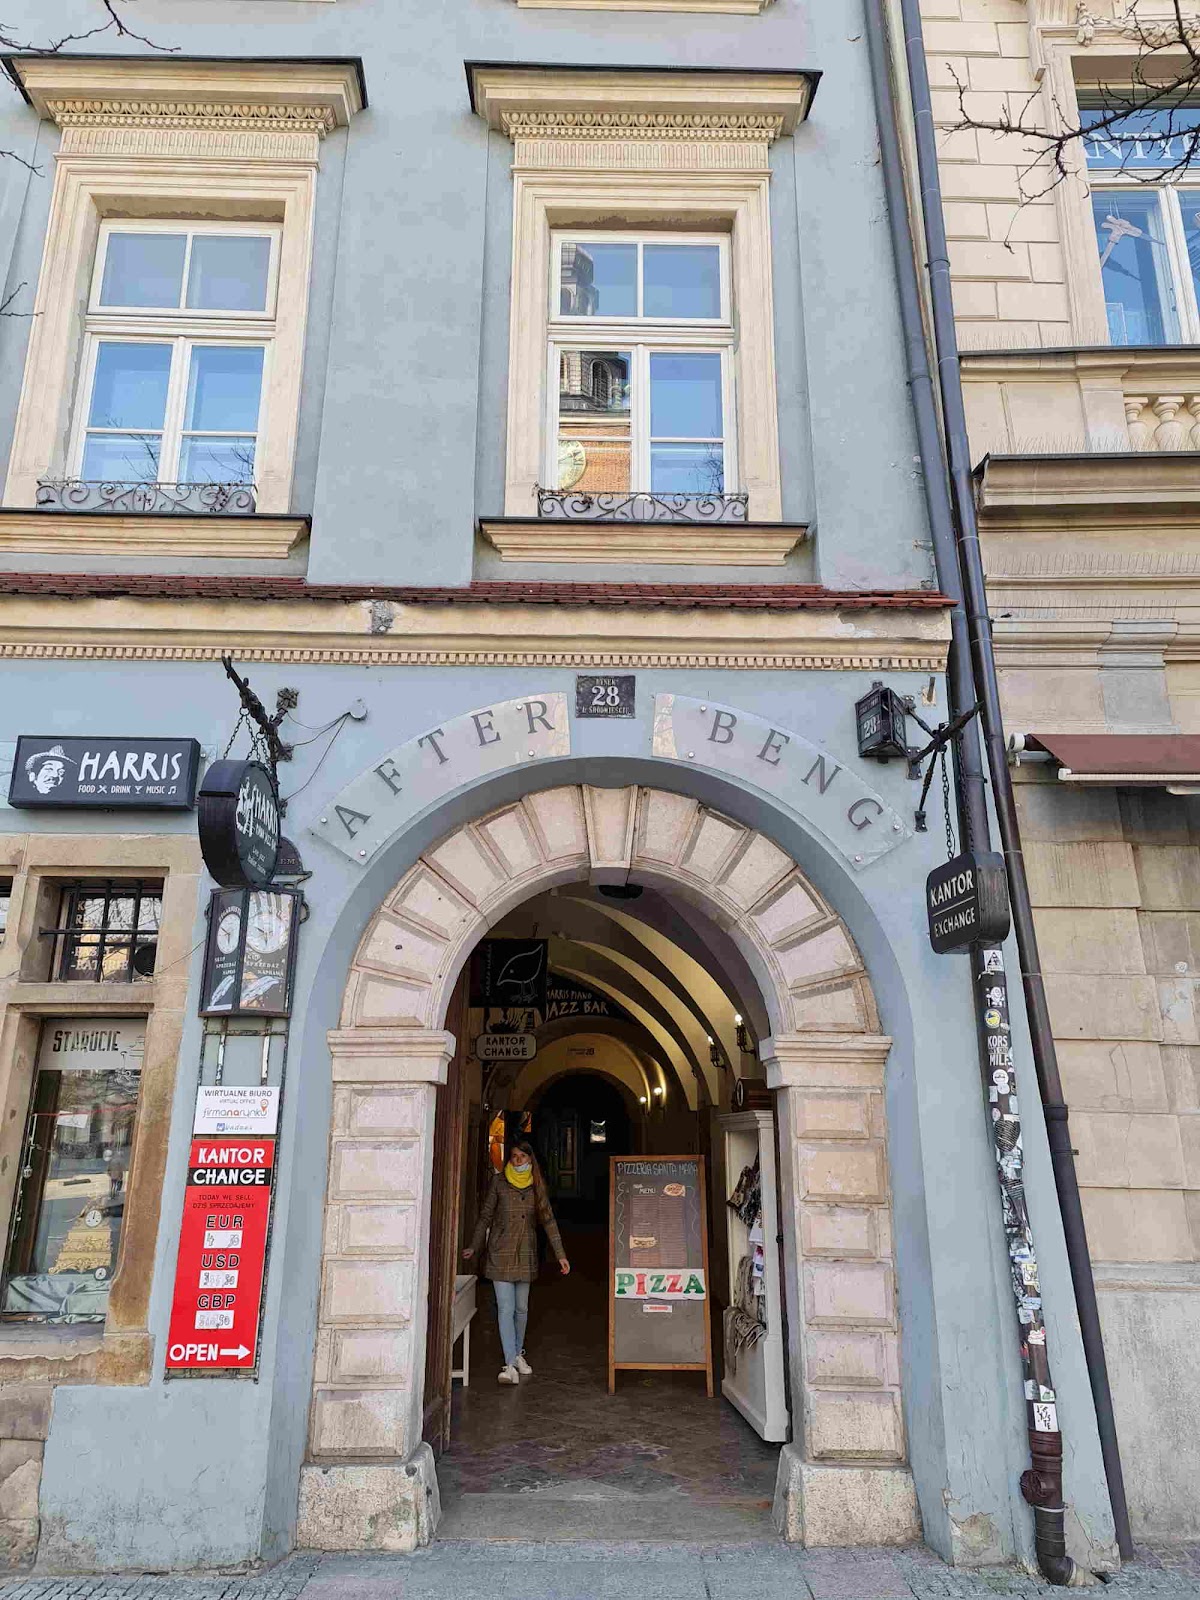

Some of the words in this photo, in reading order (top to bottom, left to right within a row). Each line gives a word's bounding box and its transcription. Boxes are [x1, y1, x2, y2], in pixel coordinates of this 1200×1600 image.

[591, 685, 620, 707] 28
[77, 750, 183, 782] HARRIS
[334, 699, 556, 841] AFTER
[707, 708, 884, 832] BENG
[77, 784, 96, 794] FOOD
[110, 785, 131, 795] DRINK
[145, 785, 166, 795] MUSIC
[930, 869, 975, 908] KANTOR
[934, 906, 977, 938] EXCHANGE
[583, 1000, 609, 1015] BAR
[486, 1036, 526, 1046] KANTOR
[484, 1047, 528, 1057] CHANGE
[198, 1148, 265, 1164] KANTOR
[193, 1169, 265, 1185] CHANGE
[206, 1214, 243, 1229] EUR
[201, 1254, 240, 1269] USD
[616, 1273, 705, 1295] PIZZA
[198, 1294, 236, 1309] GBP
[169, 1344, 219, 1361] OPEN
